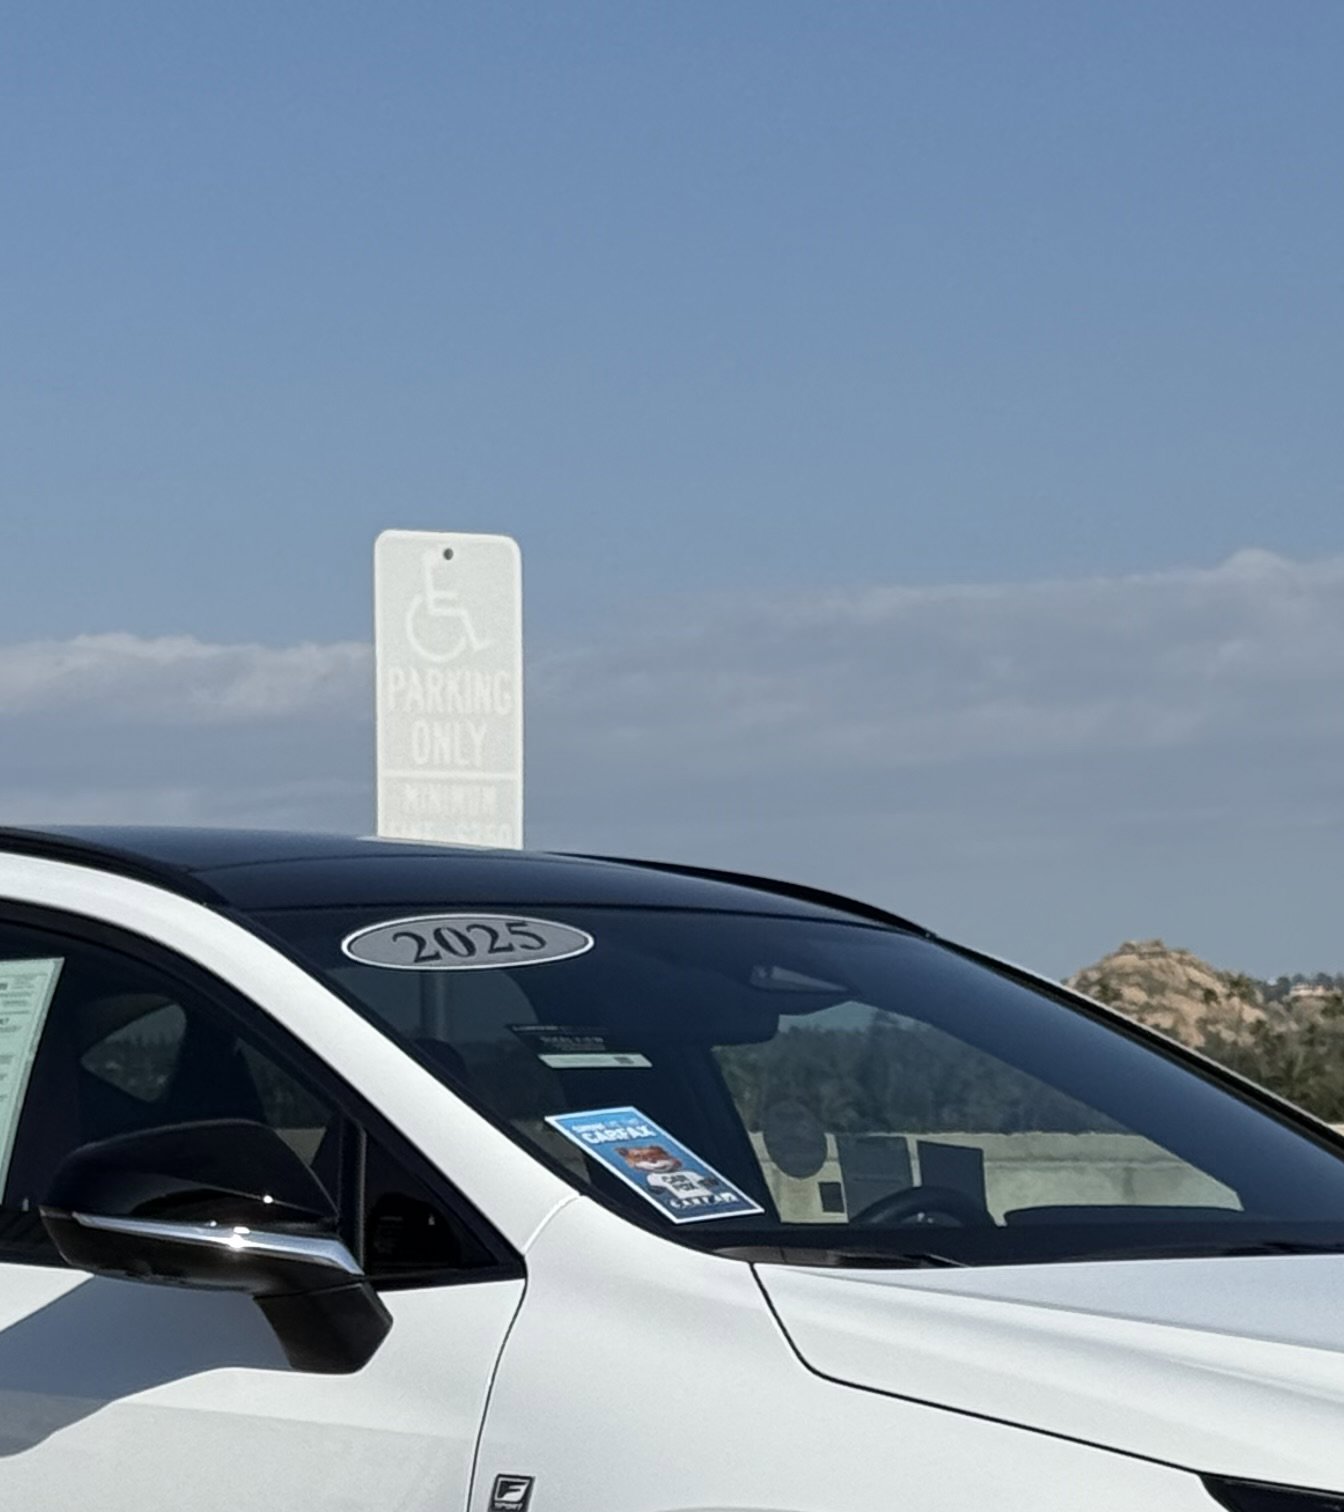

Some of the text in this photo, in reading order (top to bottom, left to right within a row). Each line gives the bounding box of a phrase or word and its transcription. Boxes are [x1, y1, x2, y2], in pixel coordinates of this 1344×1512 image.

[387, 666, 513, 715] PARKING
[411, 719, 488, 767] ONLY
[392, 921, 547, 963] 2025
[581, 1124, 657, 1144] CARFAX
